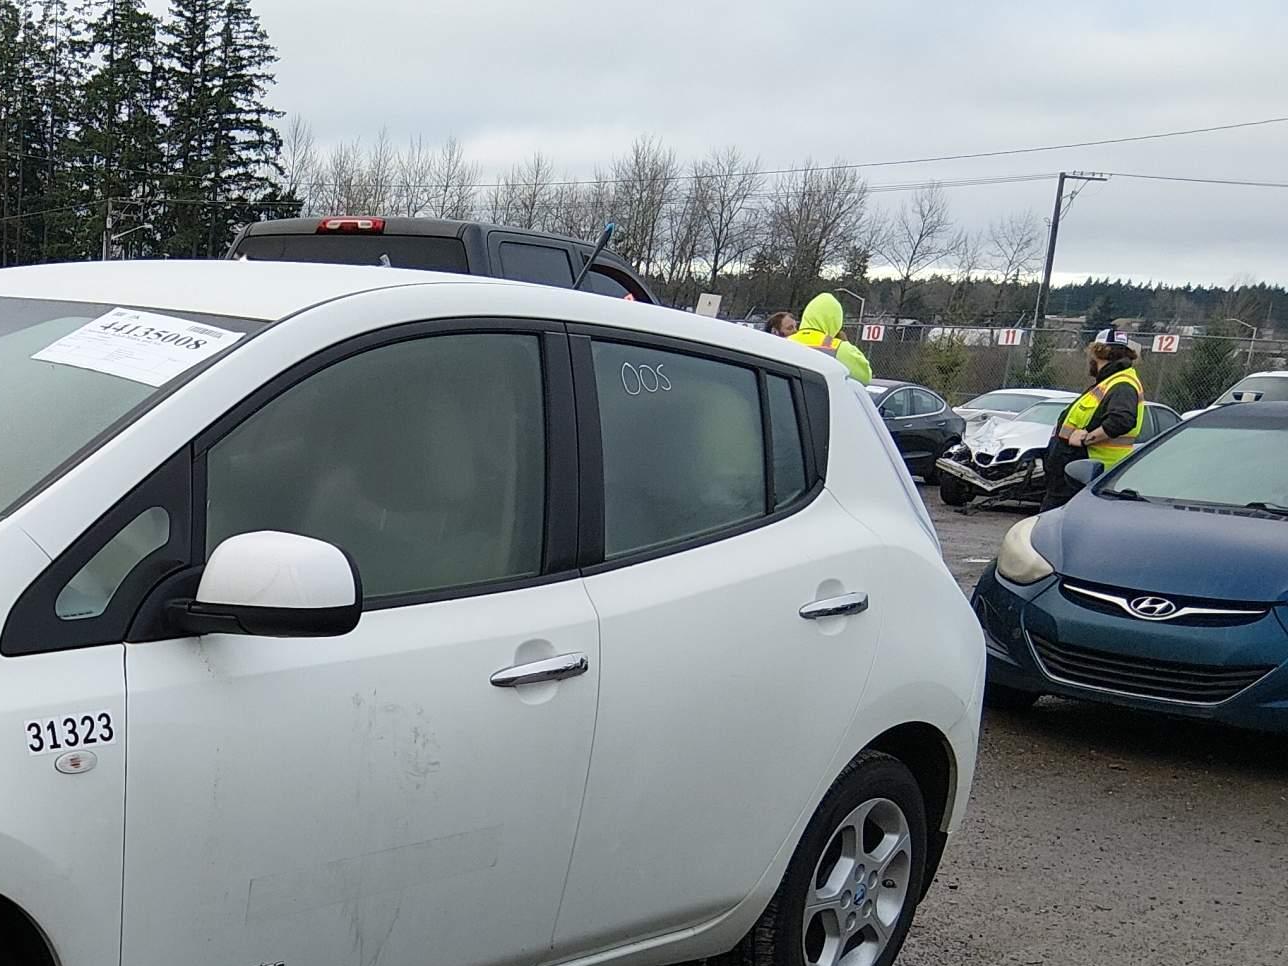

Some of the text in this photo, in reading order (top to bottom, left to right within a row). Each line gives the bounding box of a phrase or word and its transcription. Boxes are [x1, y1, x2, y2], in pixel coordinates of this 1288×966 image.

[100, 320, 208, 350] 44135008
[865, 325, 881, 340] 10
[1005, 329, 1017, 344] 11
[1157, 335, 1175, 352] 12
[27, 712, 114, 752] 31323
